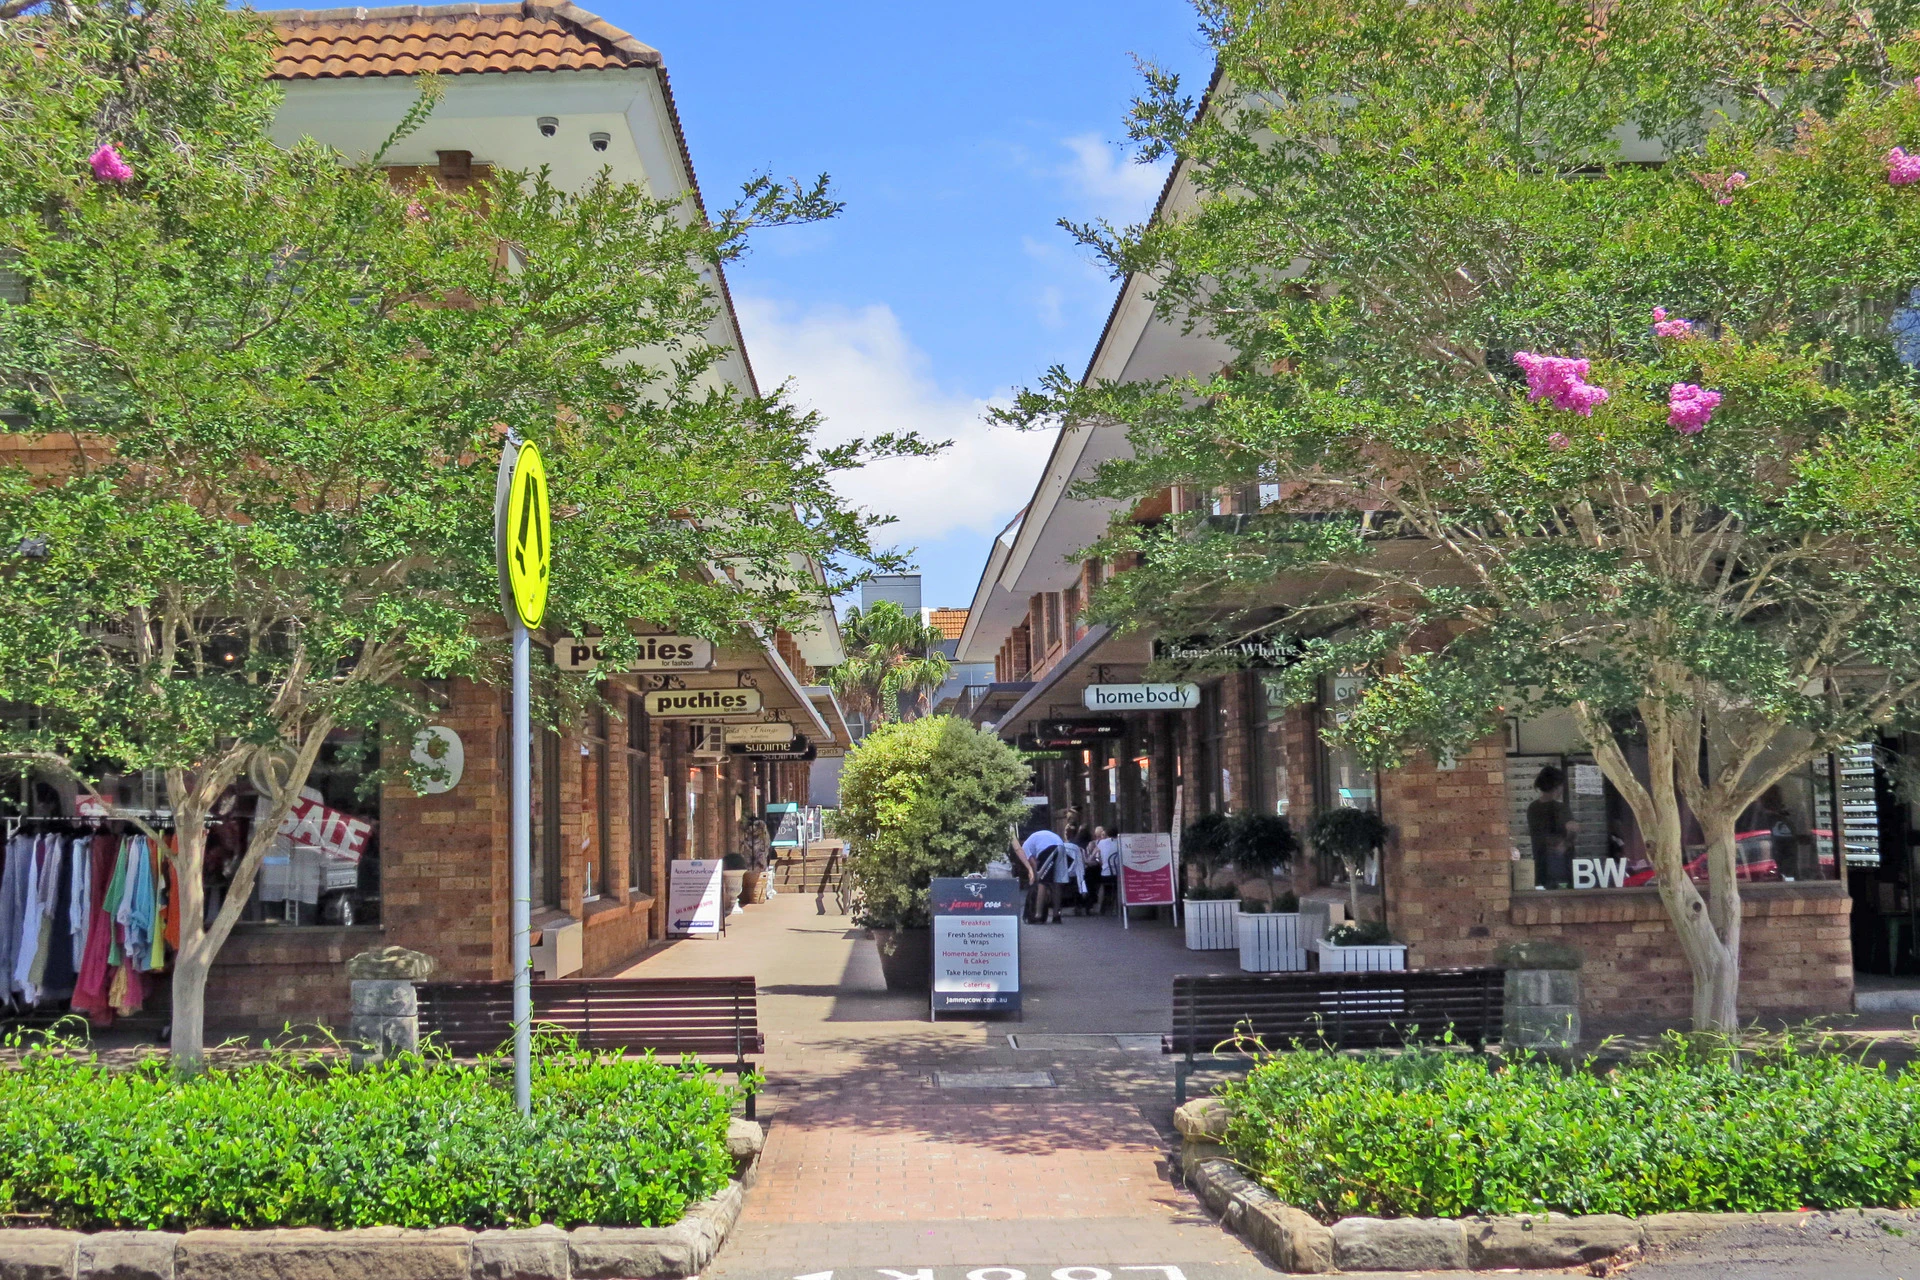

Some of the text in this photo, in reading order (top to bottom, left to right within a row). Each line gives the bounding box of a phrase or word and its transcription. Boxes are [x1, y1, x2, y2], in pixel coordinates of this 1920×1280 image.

[571, 638, 693, 666] puies
[657, 691, 747, 713] puchies
[1095, 686, 1190, 707] homebody
[1572, 857, 1627, 889] BW
[948, 899, 983, 911] jammy
[967, 931, 1005, 939] Sandwiches
